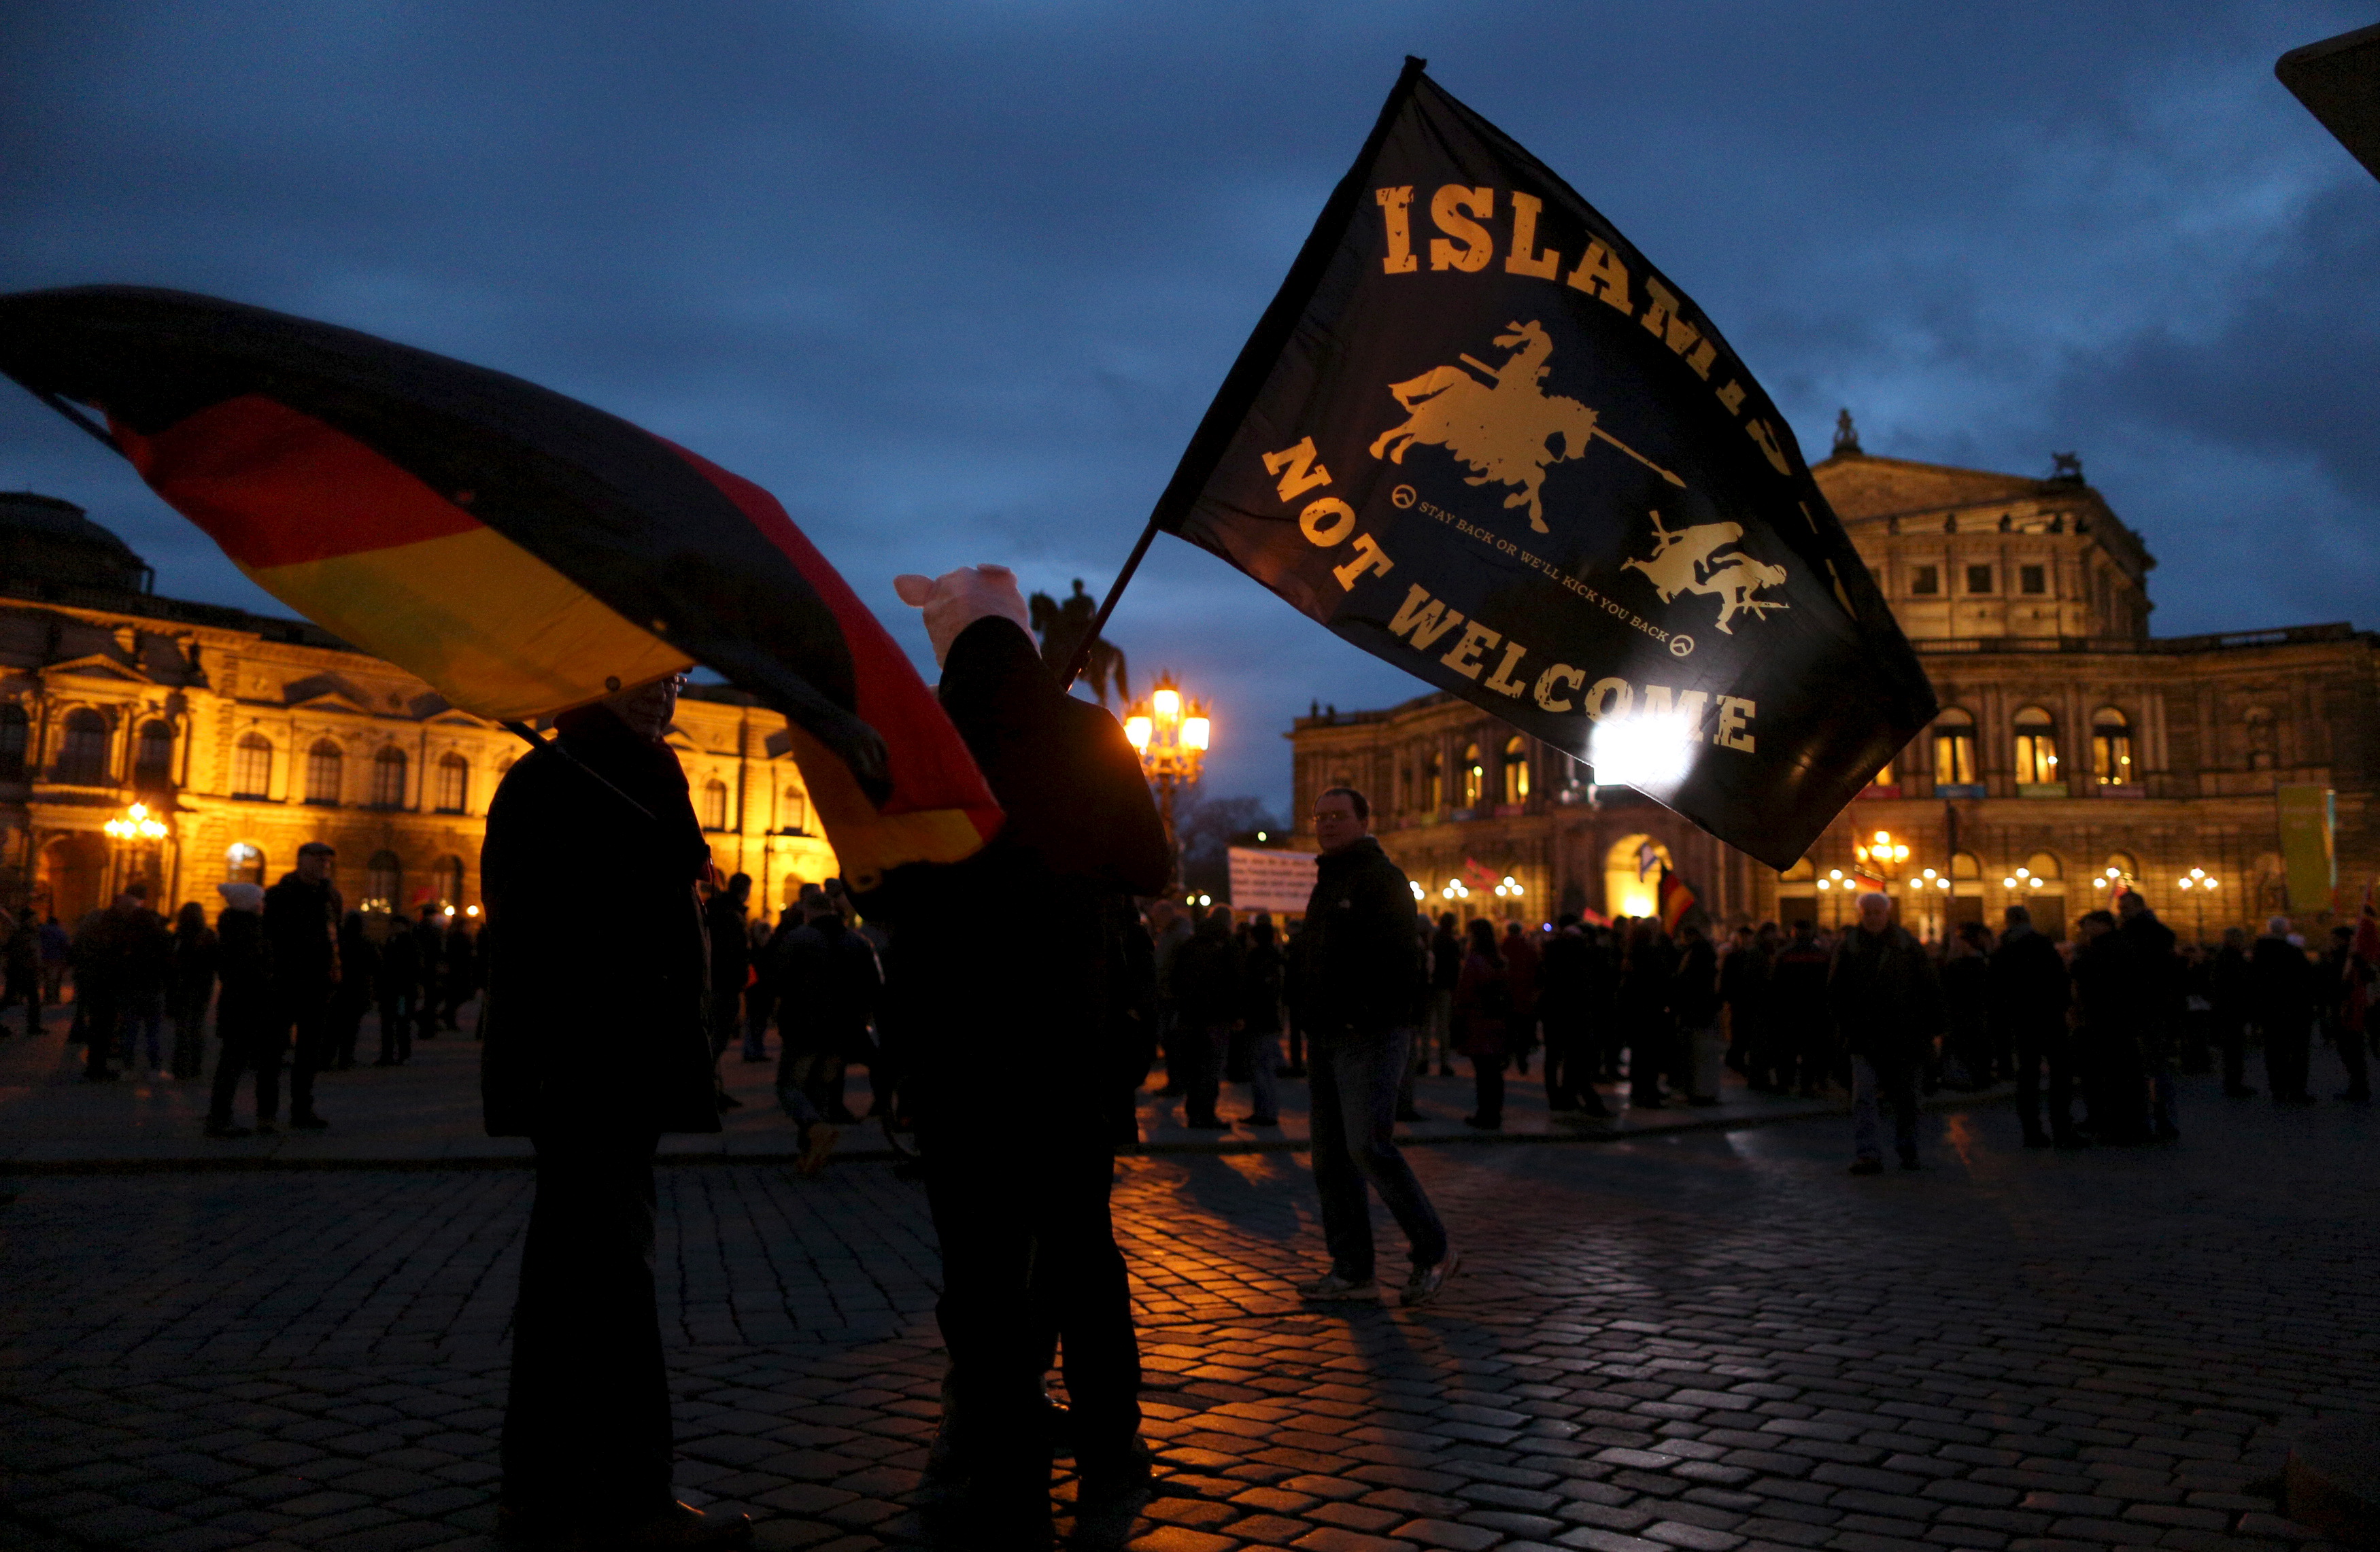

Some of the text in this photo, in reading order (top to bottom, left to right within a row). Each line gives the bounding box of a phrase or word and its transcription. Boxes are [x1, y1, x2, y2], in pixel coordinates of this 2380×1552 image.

[1261, 435, 1395, 592] NOT
[1418, 501, 1669, 642] STAY BACK OR WE'LL KICK YOU BACK
[1387, 583, 1756, 753] WELCOME
